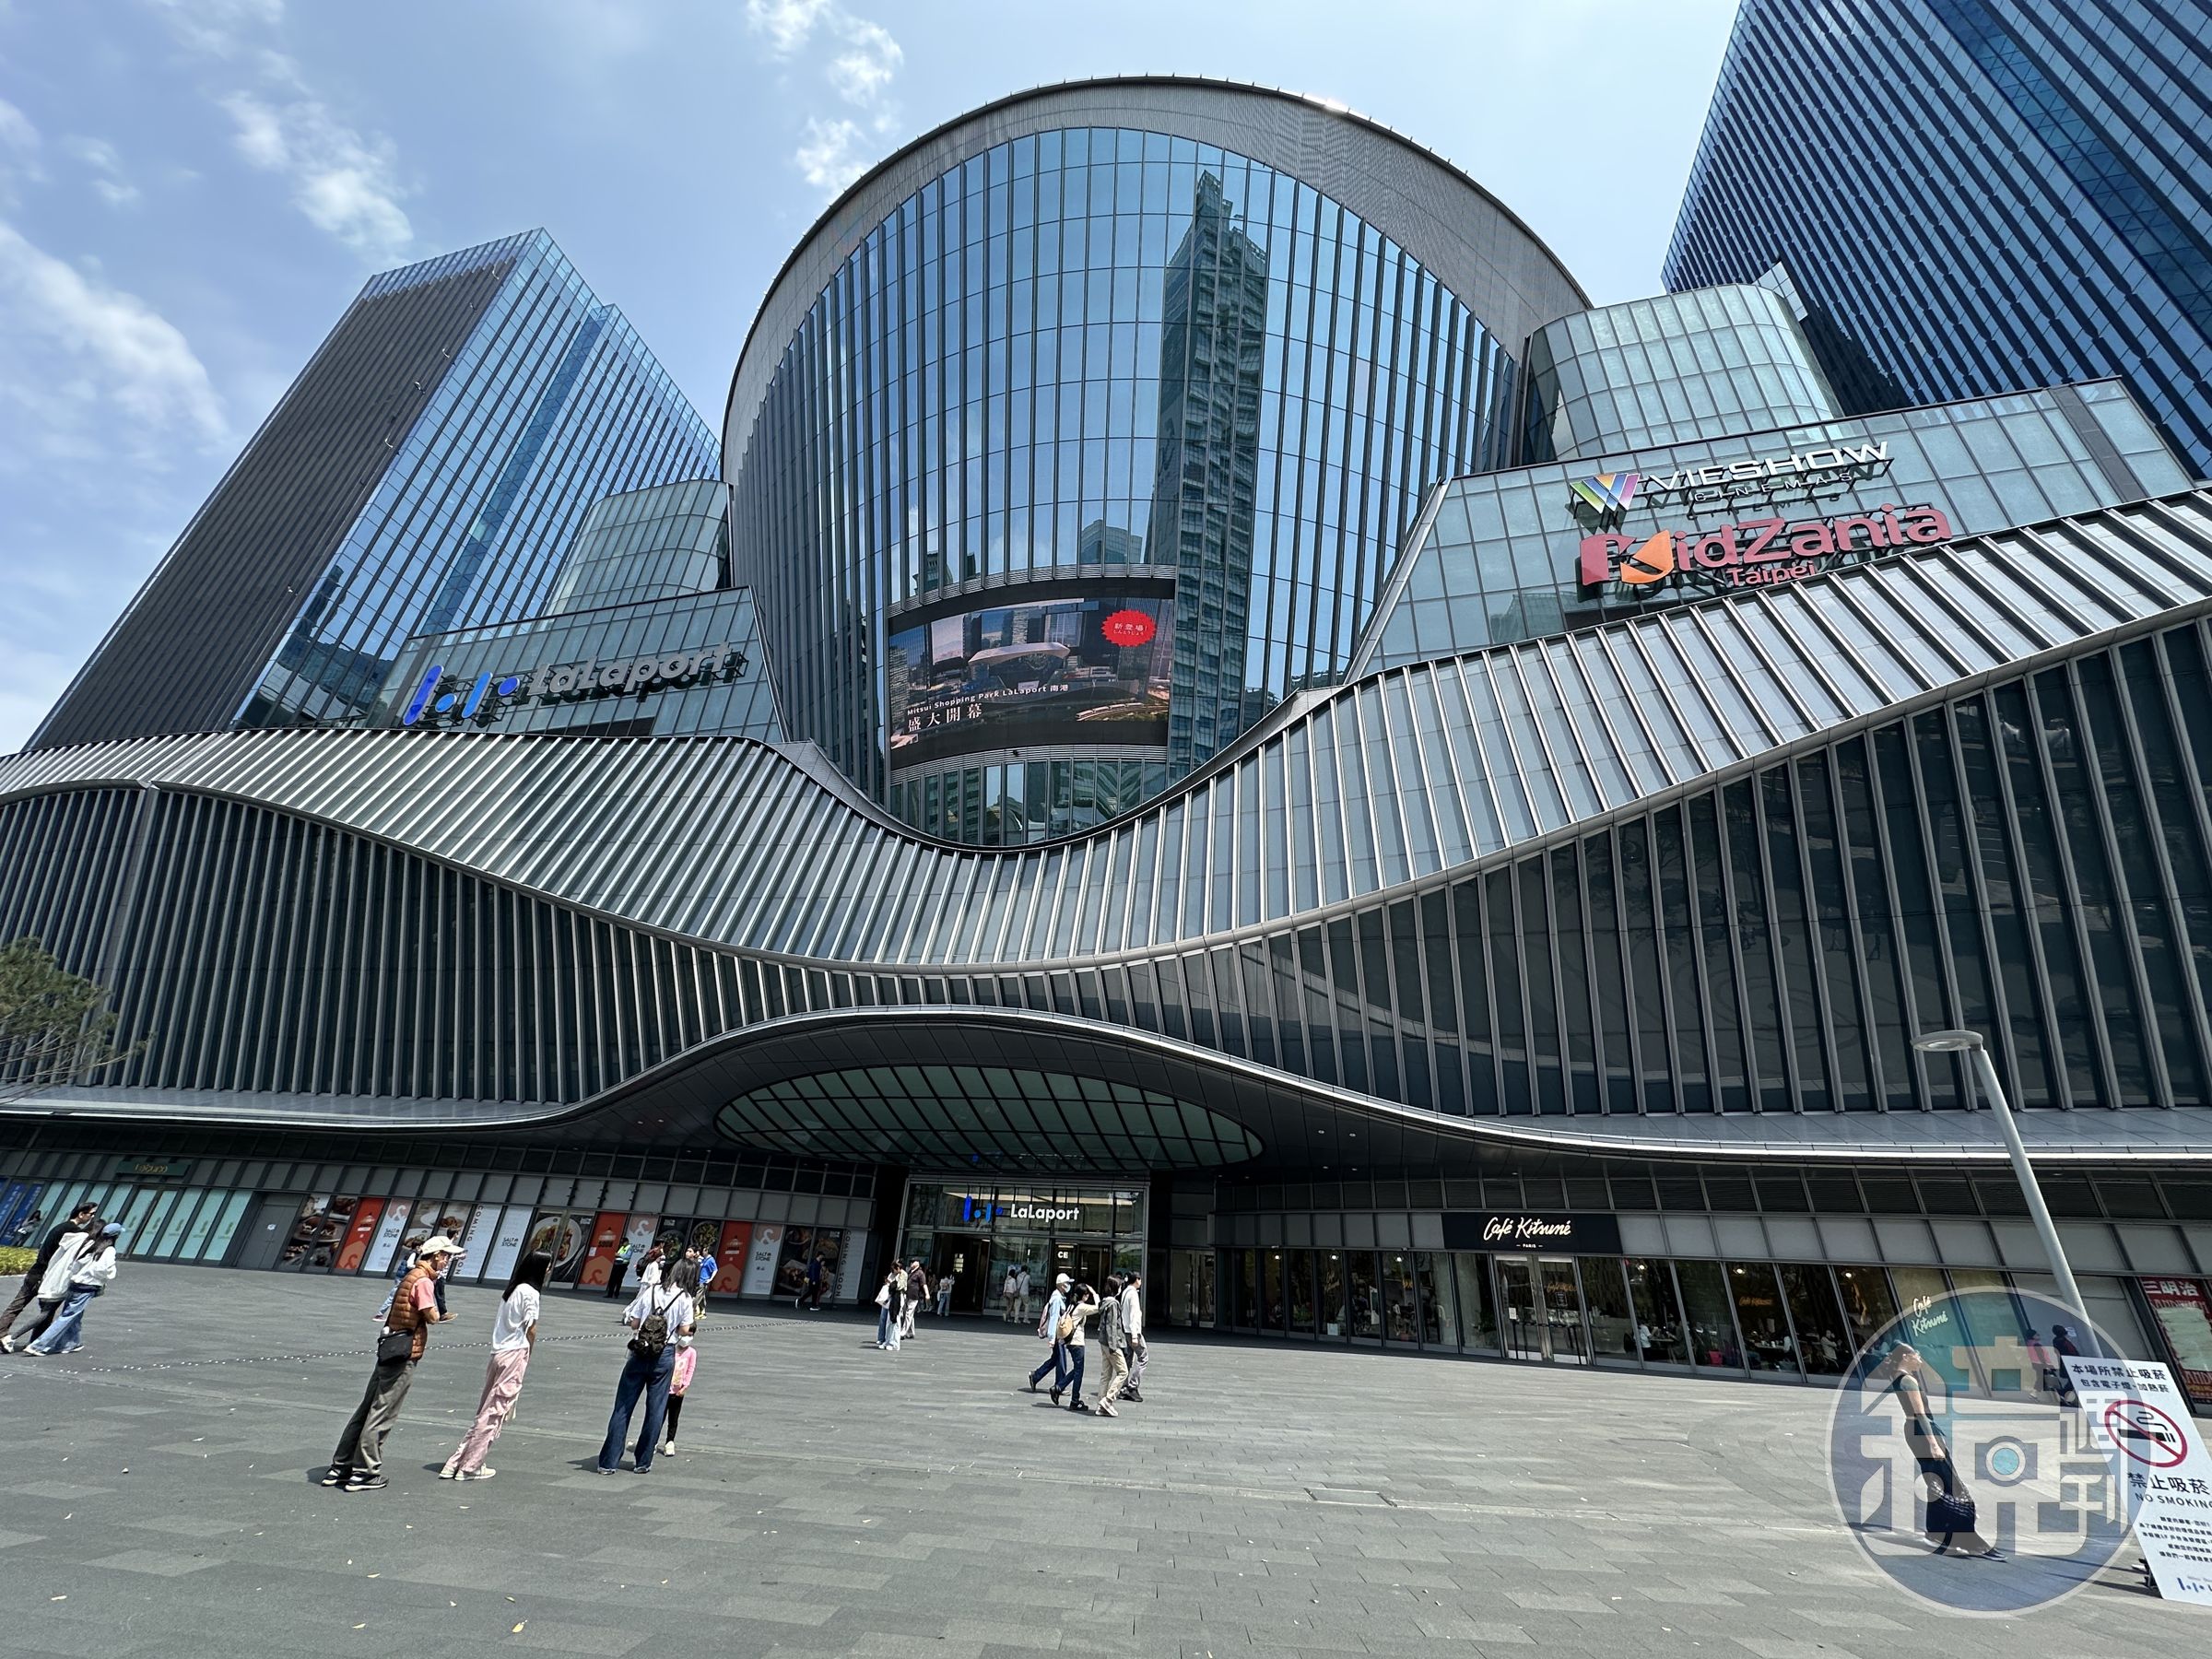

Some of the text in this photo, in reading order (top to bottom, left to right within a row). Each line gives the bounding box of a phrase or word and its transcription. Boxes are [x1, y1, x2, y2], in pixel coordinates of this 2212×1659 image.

[1649, 441, 1888, 490] VIESHOW
[1694, 473, 1853, 502] CINEMAS
[1580, 503, 1953, 585] KidZania
[1726, 560, 1816, 586] Taipei
[526, 641, 732, 697] LaLaport
[907, 684, 1069, 715] Mitsui Shopping Park LaLaport 南港
[908, 703, 982, 732] 盛大開幕
[467, 1205, 484, 1241] COMING
[1010, 1203, 1080, 1223] LaLaport
[1483, 1217, 1571, 1241] Café Kitsuné
[2143, 1280, 2199, 1297] 三明治
[1912, 1295, 1932, 1318] Café
[1911, 1311, 1948, 1336] Kitsuné
[2071, 1364, 2167, 1381] 本場所禁止吸菸
[2127, 1472, 2210, 1495] 禁止吸菸
[2135, 1492, 2154, 1502] NO
